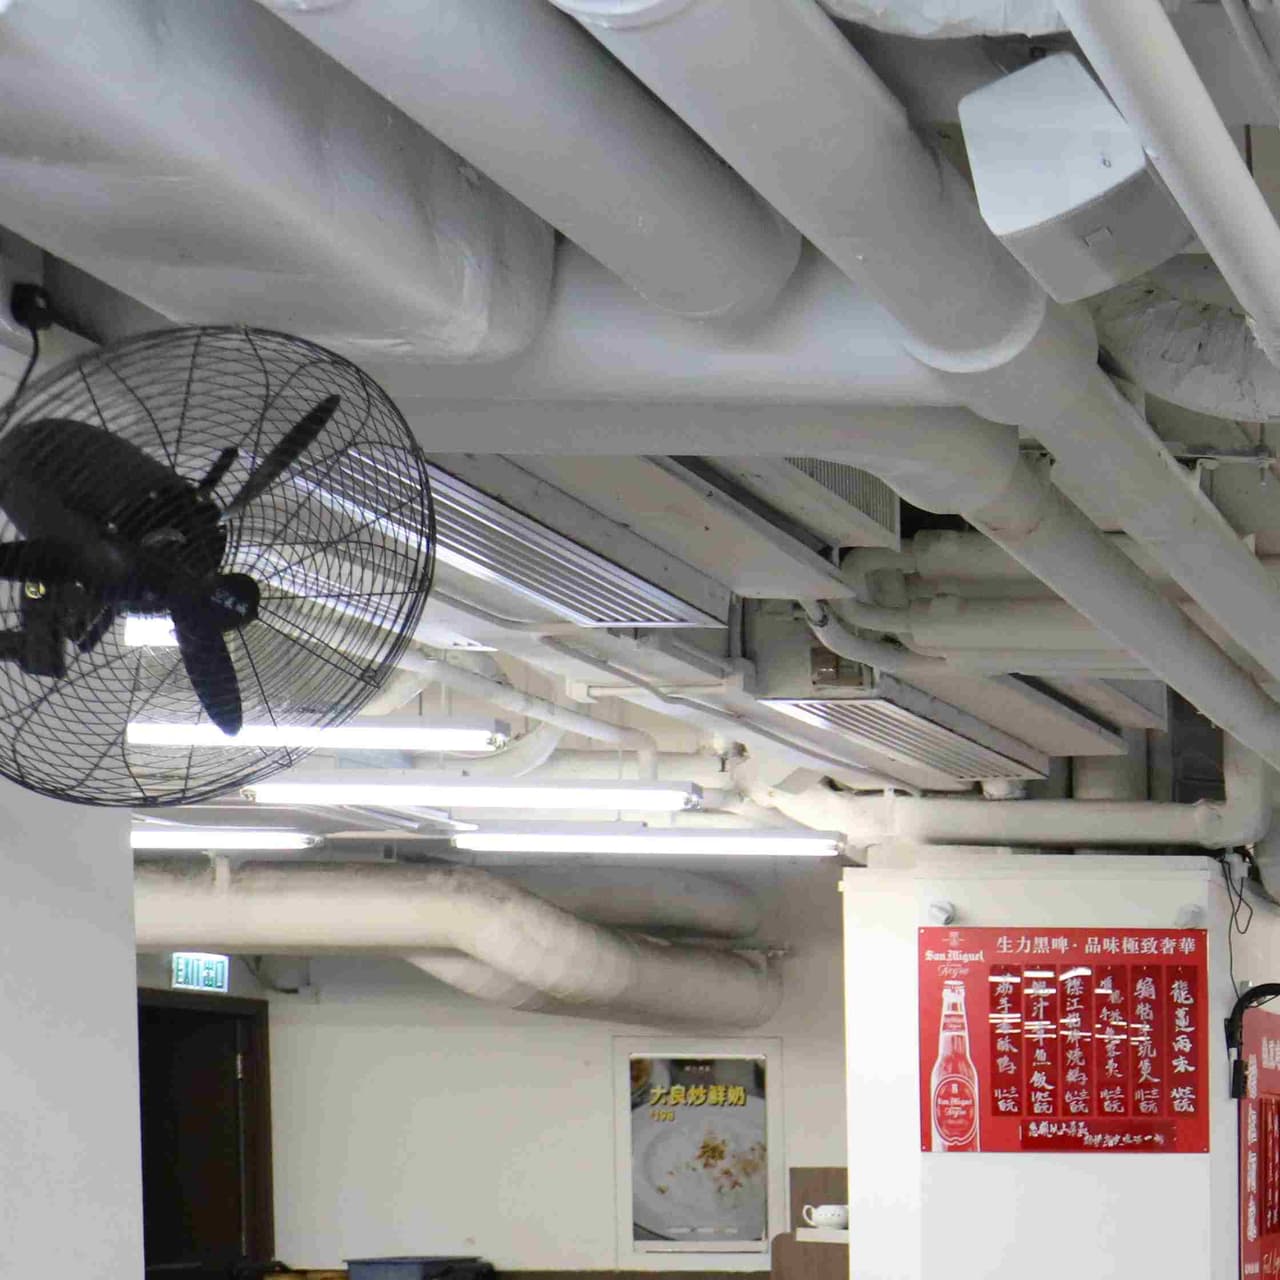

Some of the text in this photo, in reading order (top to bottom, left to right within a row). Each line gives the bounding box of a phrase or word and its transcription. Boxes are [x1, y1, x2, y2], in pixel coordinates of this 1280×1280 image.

[924, 949, 984, 963] San Miguel
[175, 955, 225, 989] EXIT 出口
